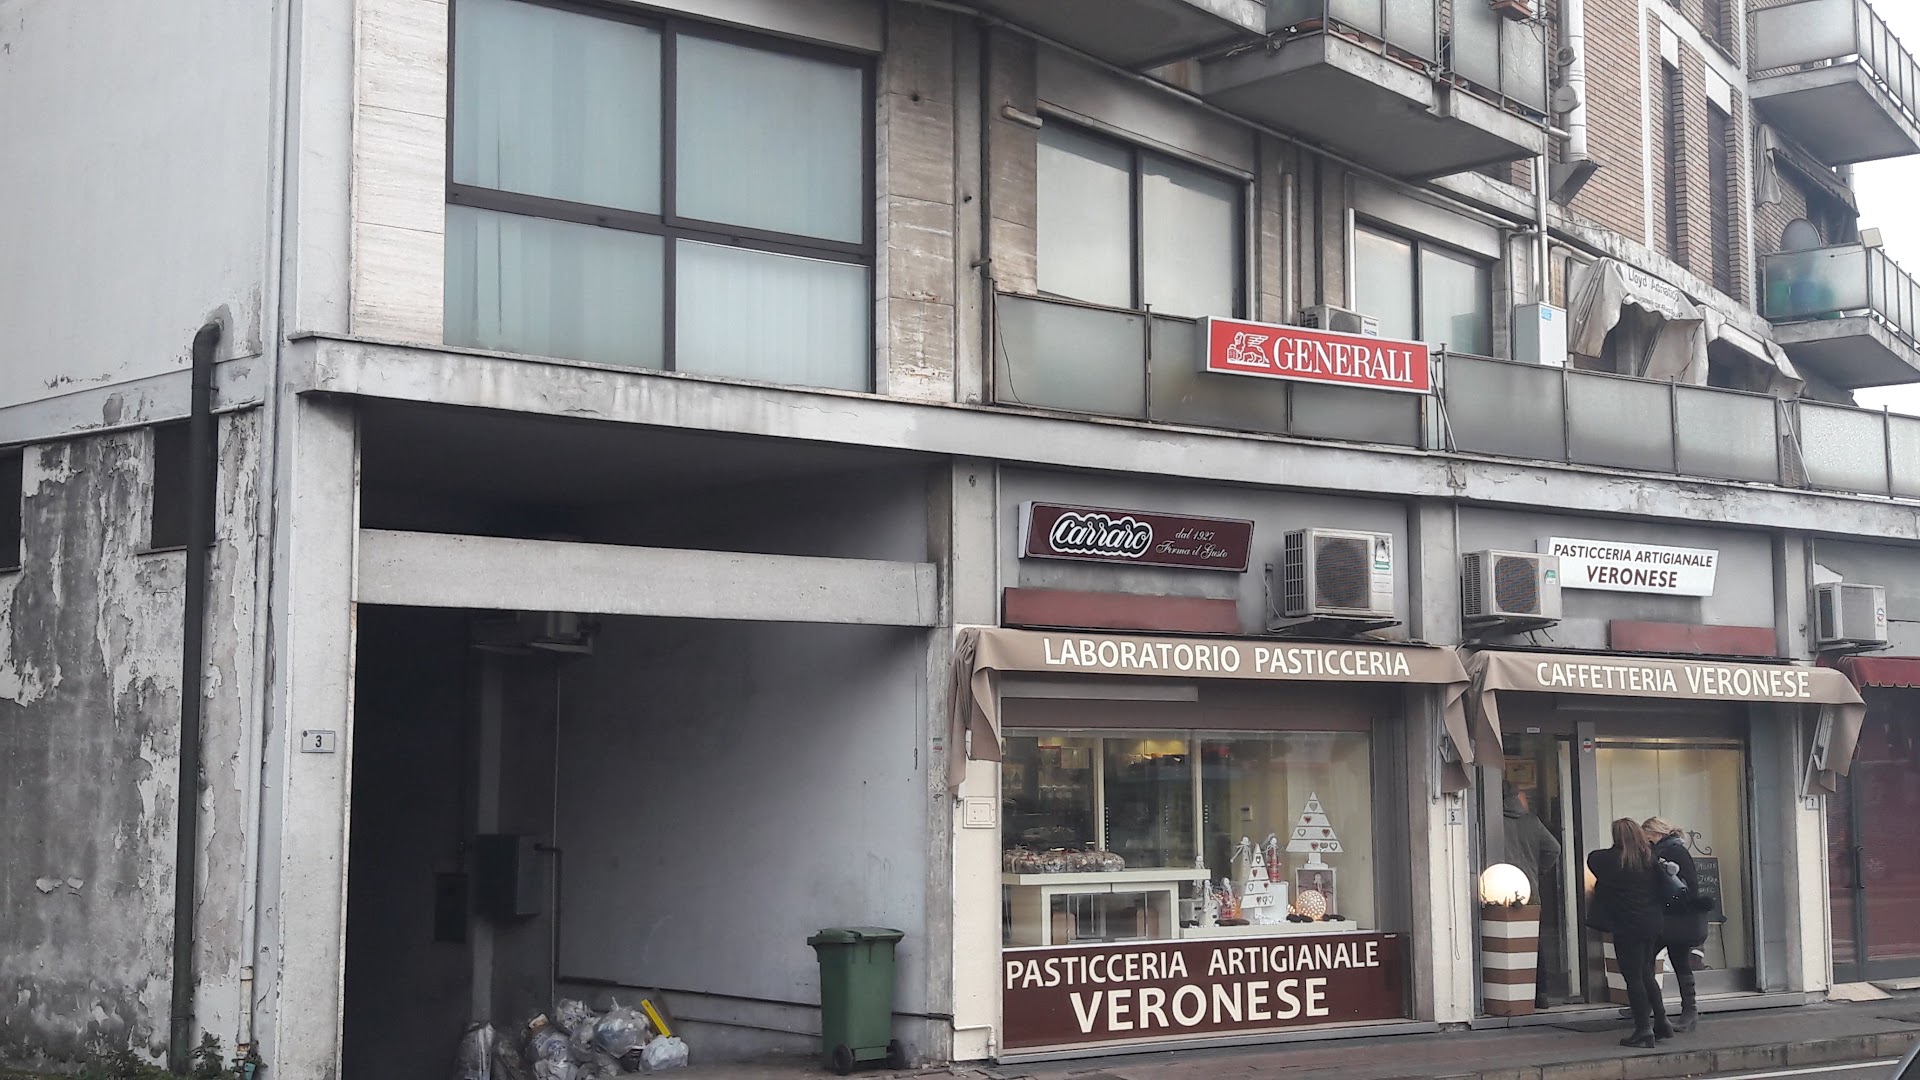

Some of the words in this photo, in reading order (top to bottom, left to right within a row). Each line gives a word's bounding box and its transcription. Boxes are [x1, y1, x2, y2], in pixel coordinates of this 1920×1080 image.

[1628, 268, 1648, 288] Lloyd
[1273, 336, 1414, 384] GENERALI
[1175, 527, 1194, 539] dal
[1193, 530, 1215, 541] 1927
[1191, 545, 1202, 556] il
[1200, 543, 1228, 560] Gusto
[1554, 544, 1632, 562] PASTICCERIA
[1635, 551, 1713, 568] ARTIGIANALE
[1587, 565, 1678, 588] VERONESE
[1043, 638, 1240, 672] LABORATORIO
[1255, 646, 1410, 676] PASTICCERIA
[1536, 661, 1677, 692] CAFFETTERIA
[1684, 665, 1811, 698] VERONESE
[315, 735, 322, 748] 3
[1006, 950, 1189, 990] PASTICCERIA
[1207, 940, 1381, 977] ARTIGIANALE
[1070, 977, 1330, 1034] VERONESE
